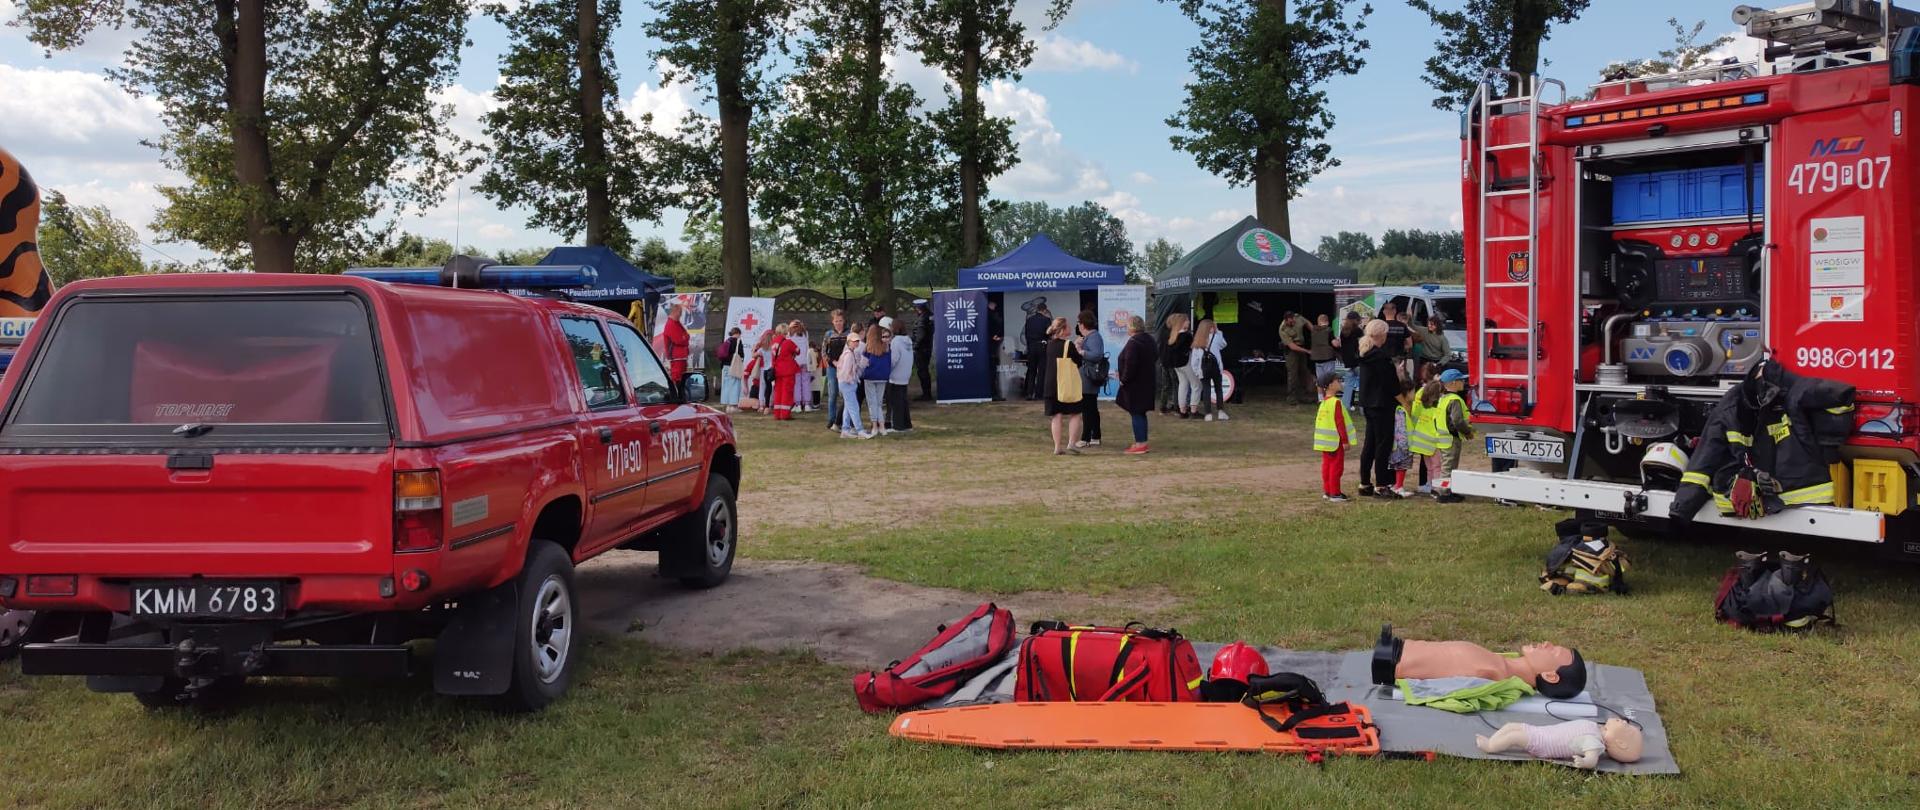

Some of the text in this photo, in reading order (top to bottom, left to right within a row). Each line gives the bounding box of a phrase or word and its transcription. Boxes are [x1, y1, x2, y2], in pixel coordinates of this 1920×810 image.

[977, 270, 1108, 281] KOMENDA POWIATOWA POLICJI
[1025, 280, 1058, 288] W KOLE
[609, 288, 615, 296] w
[946, 333, 979, 343] POLICJA
[1796, 347, 1895, 370] 998 112
[1493, 439, 1563, 458] PKL 42576
[134, 586, 276, 615] KMM 6783
